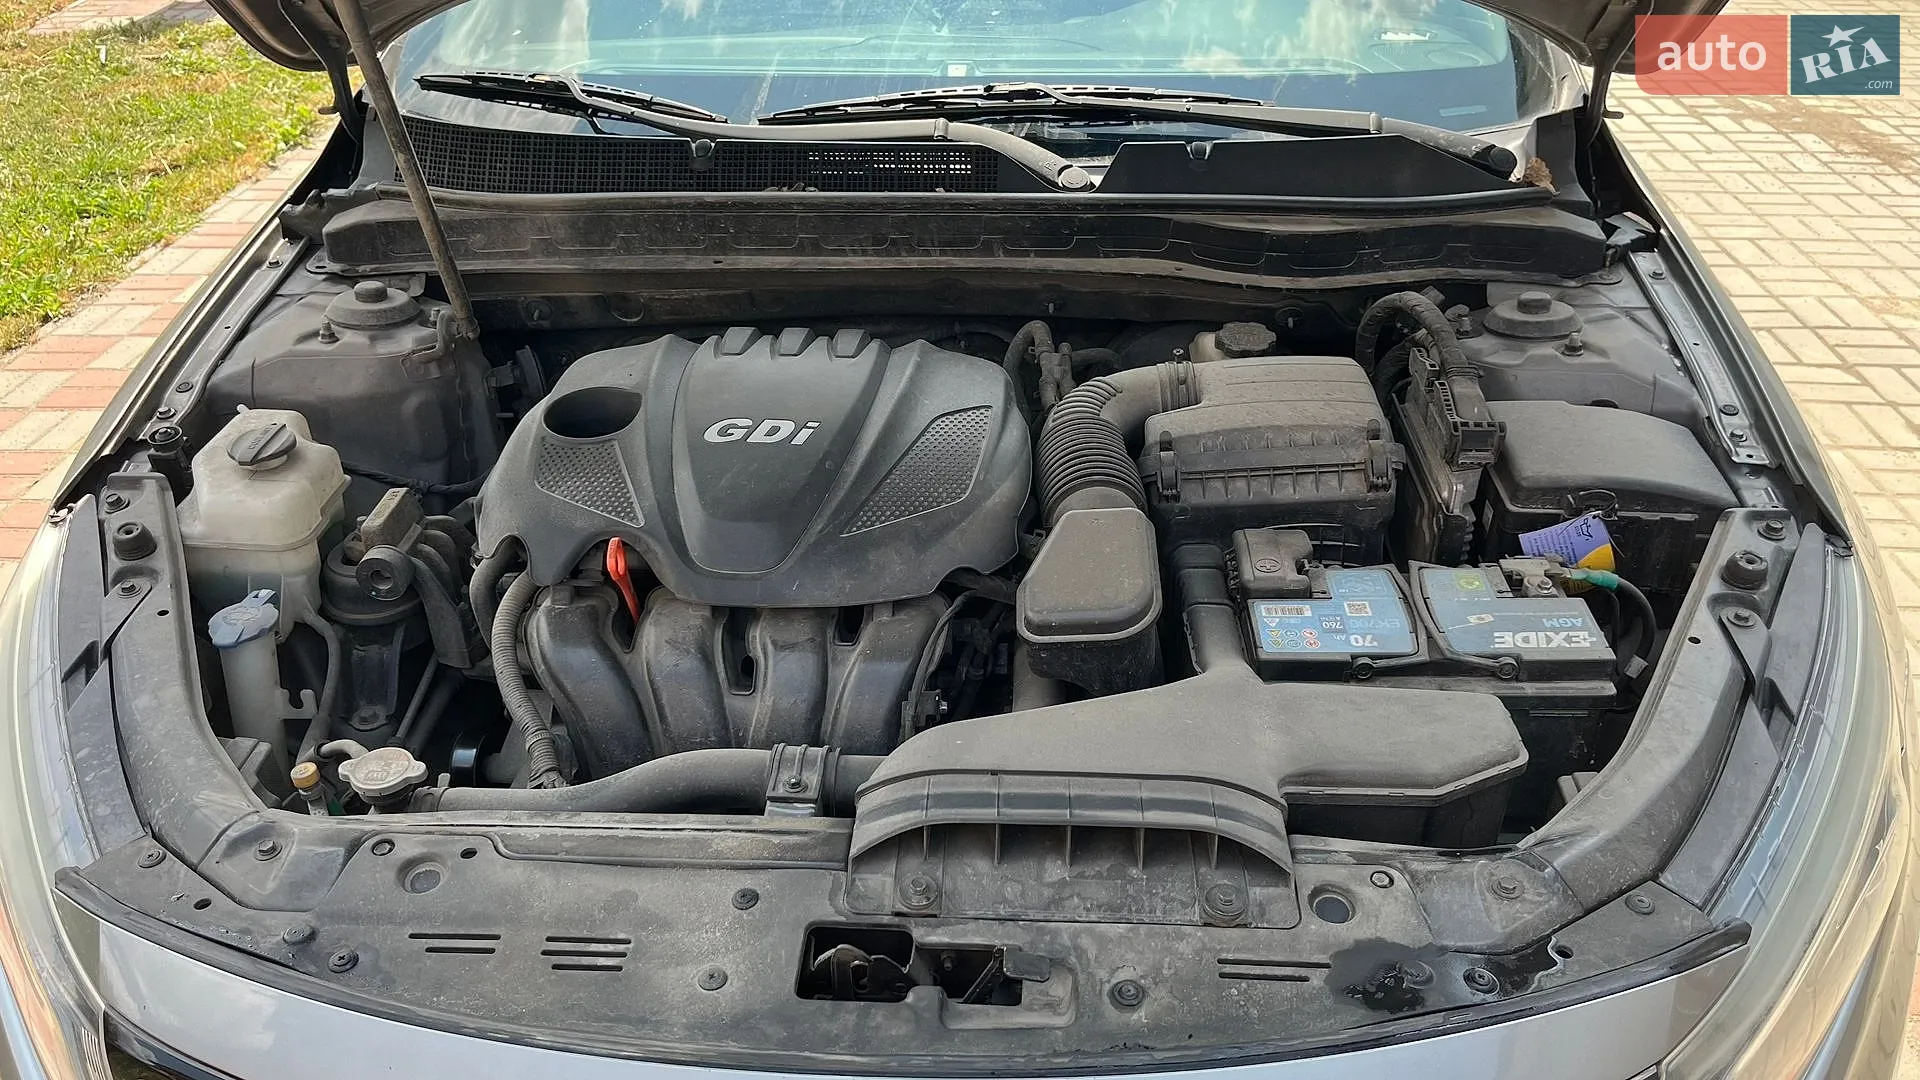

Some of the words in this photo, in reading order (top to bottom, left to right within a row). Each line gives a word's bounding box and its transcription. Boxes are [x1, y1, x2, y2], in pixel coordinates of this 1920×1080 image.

[702, 417, 822, 446] GDi
[1322, 621, 1344, 629] 760
[1542, 617, 1584, 627] AGM
[1349, 634, 1378, 648] 70
[1492, 631, 1597, 648] EXIDE
